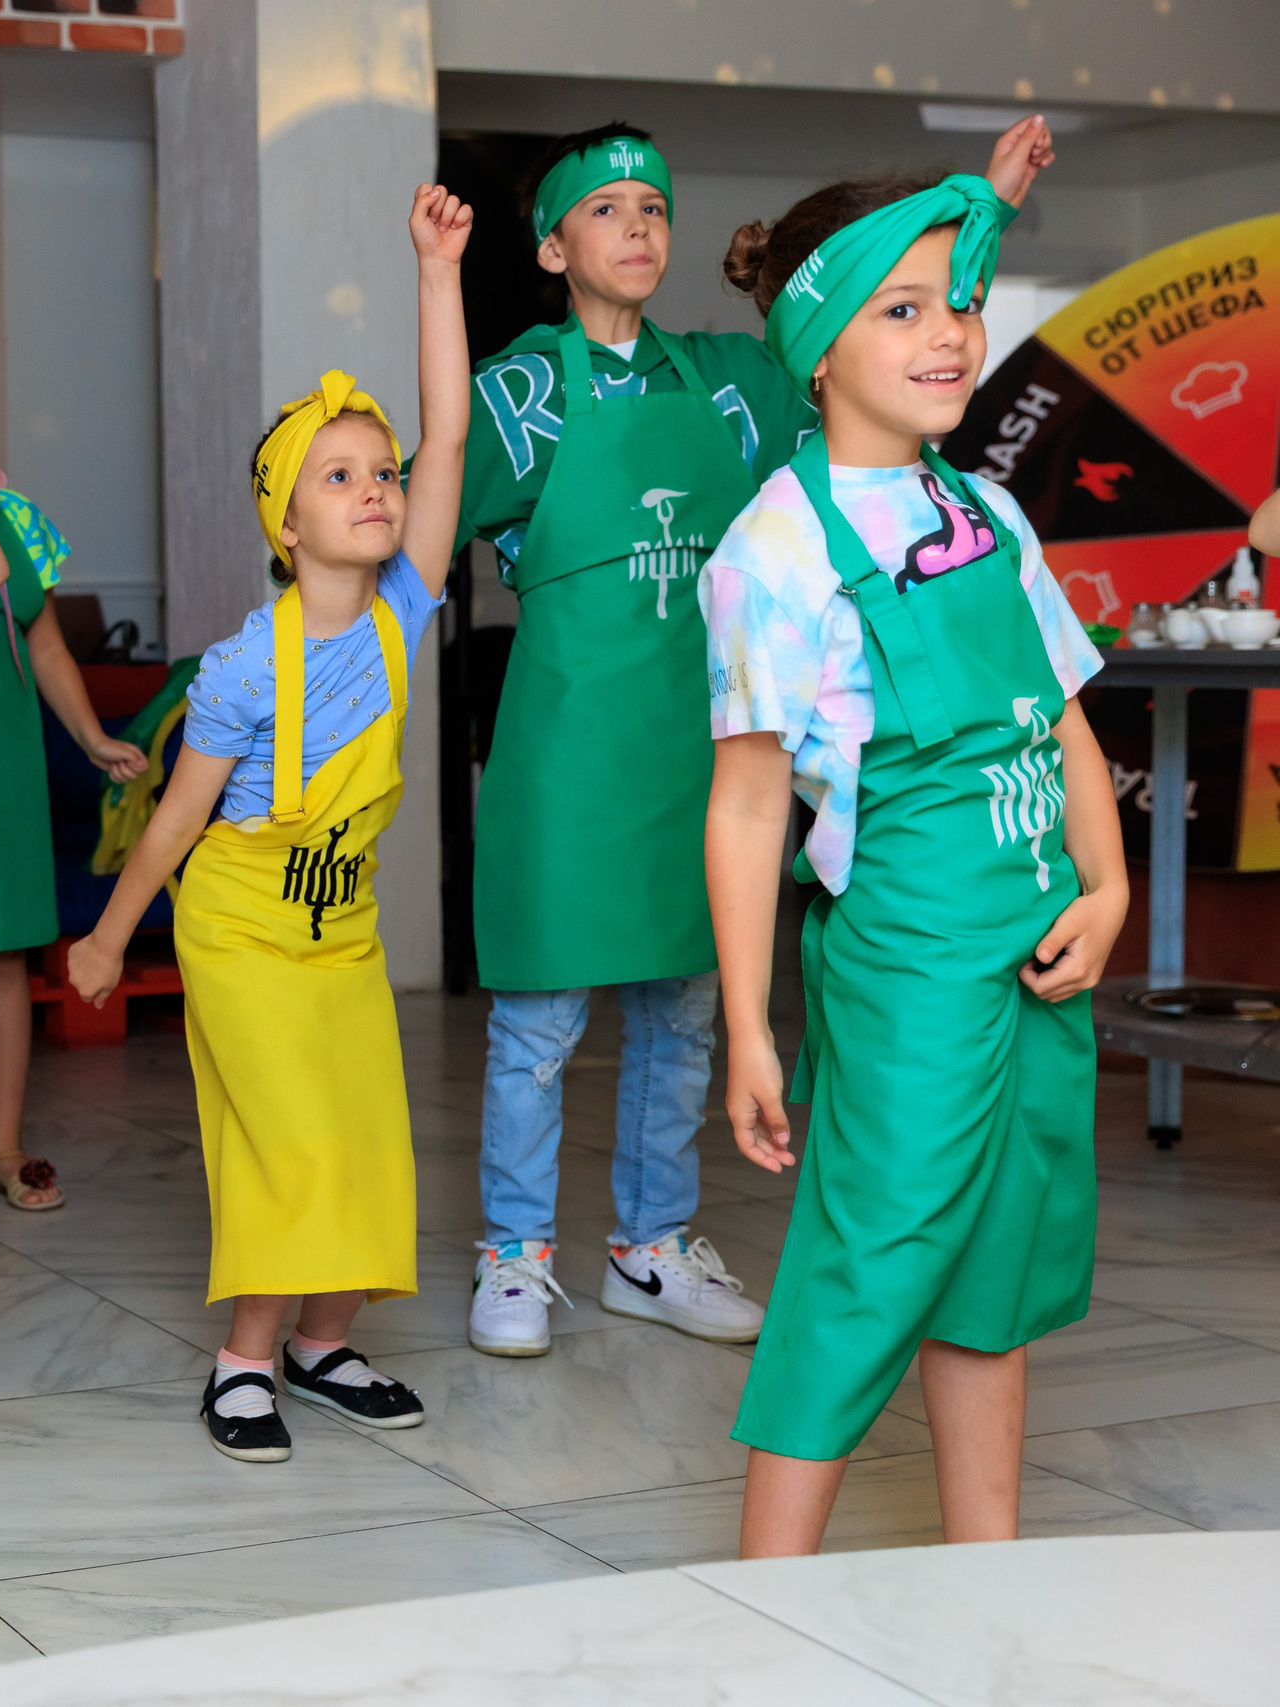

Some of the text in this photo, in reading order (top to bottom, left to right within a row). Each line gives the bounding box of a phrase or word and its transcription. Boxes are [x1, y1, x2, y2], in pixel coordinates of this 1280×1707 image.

[1084, 255, 1259, 351] СЮРПРИЗ
[1100, 287, 1267, 377] ОТ ШЕФА
[975, 383, 1061, 484] RASH
